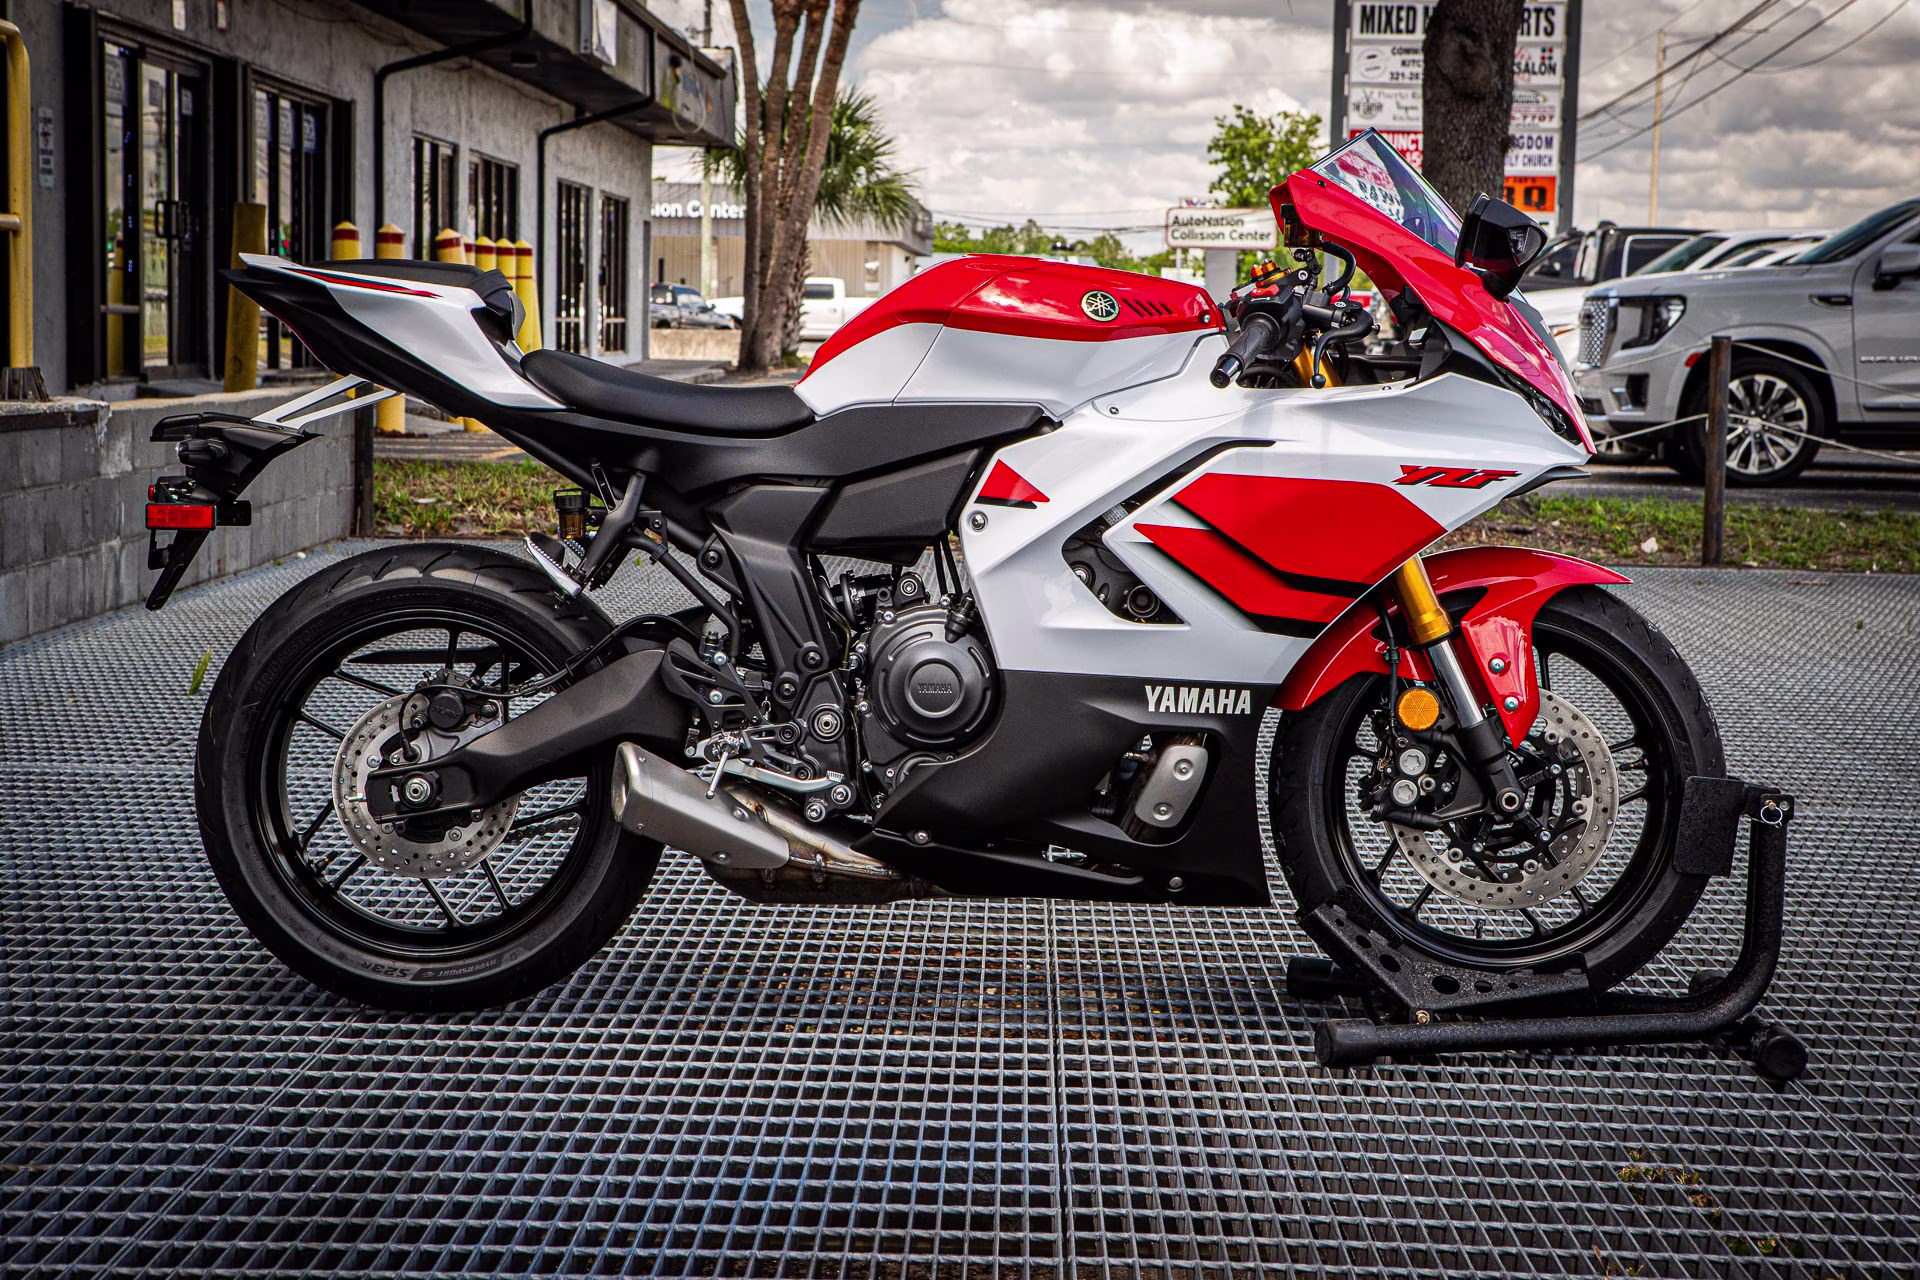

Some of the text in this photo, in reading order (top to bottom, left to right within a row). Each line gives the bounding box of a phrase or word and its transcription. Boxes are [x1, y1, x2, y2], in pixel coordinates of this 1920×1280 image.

[1360, 5, 1417, 34] MIXED
[1520, 7, 1555, 37] RTS
[1513, 62, 1557, 75] SALON
[1516, 135, 1554, 150] GDOM
[1523, 154, 1553, 167] CHURCH
[1172, 215, 1245, 227] AutoNation
[1171, 229, 1272, 241] Collision Center
[917, 682, 953, 694] YAMAHA
[1144, 685, 1251, 715] YAMAHA
